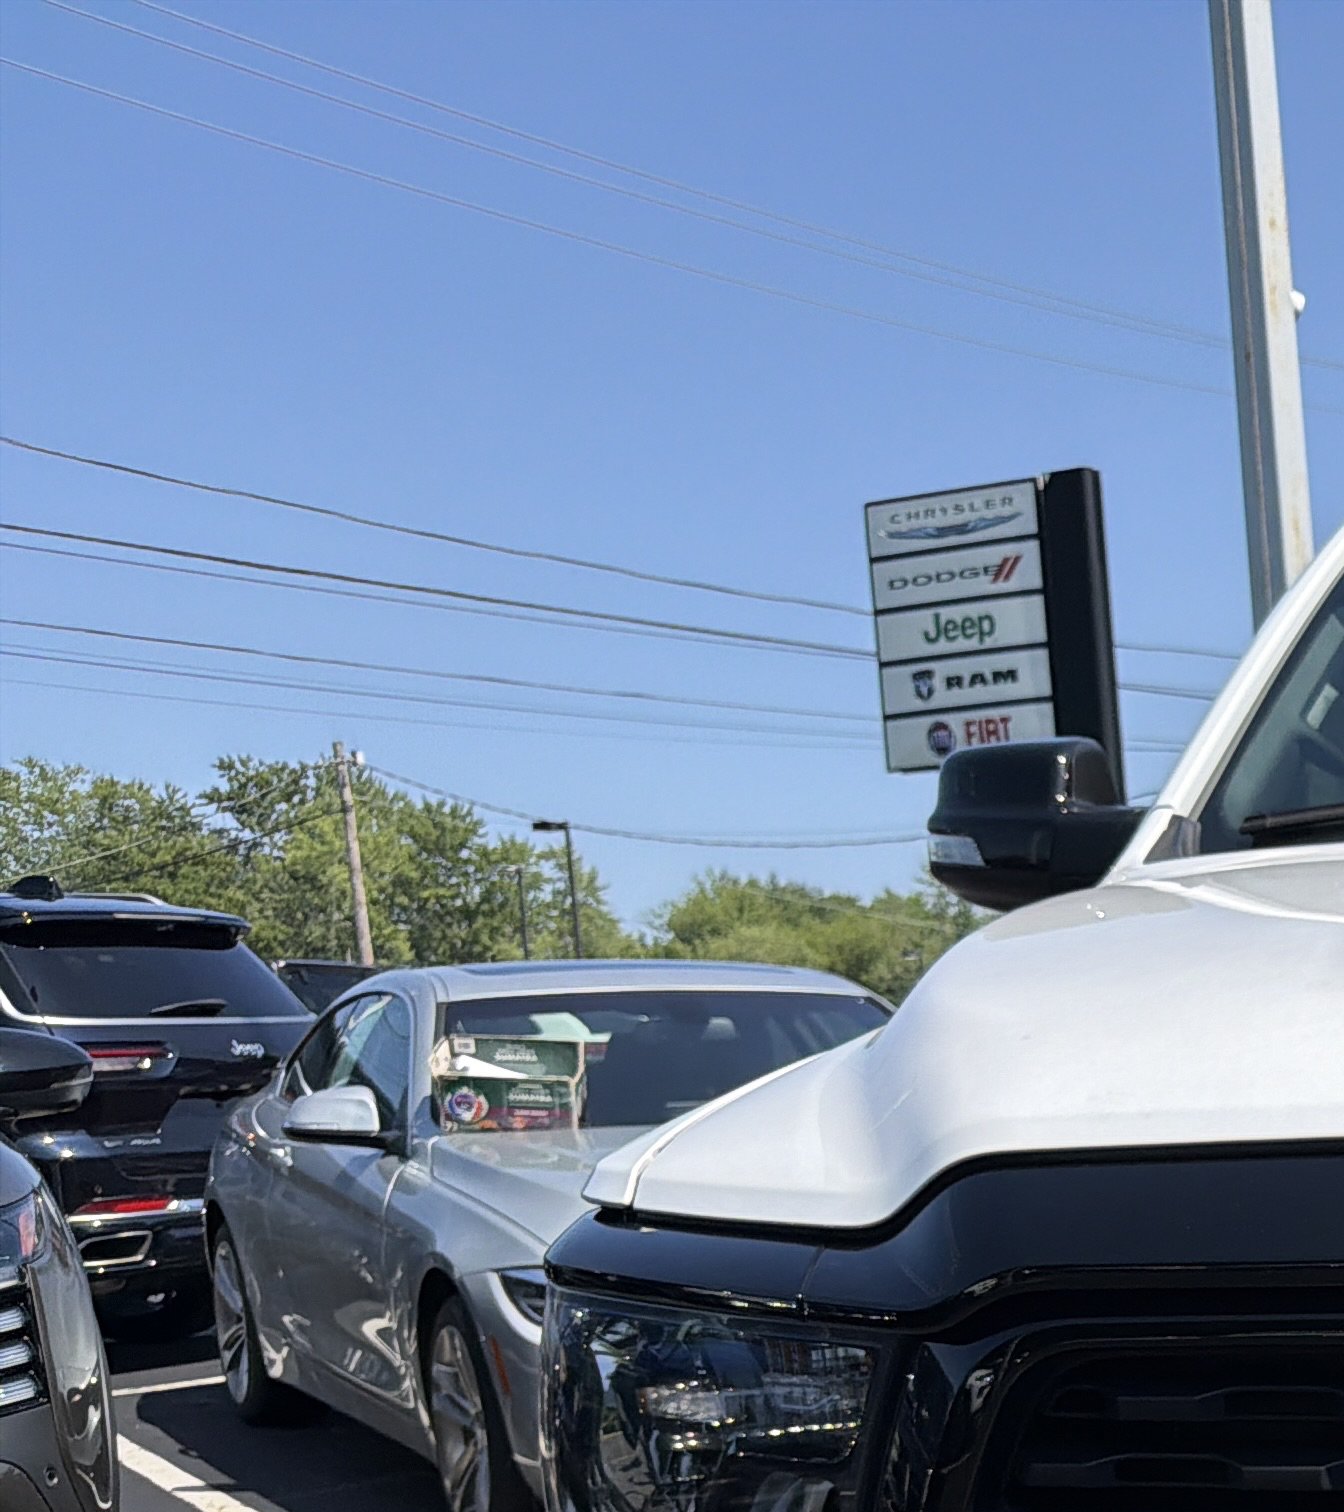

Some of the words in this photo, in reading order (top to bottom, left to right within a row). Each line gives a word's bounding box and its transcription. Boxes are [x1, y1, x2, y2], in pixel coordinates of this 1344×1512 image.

[889, 496, 1014, 525] CHRYSLER
[888, 564, 1003, 590] DODGE
[923, 612, 997, 645] Jeep
[945, 669, 1018, 690] RAM
